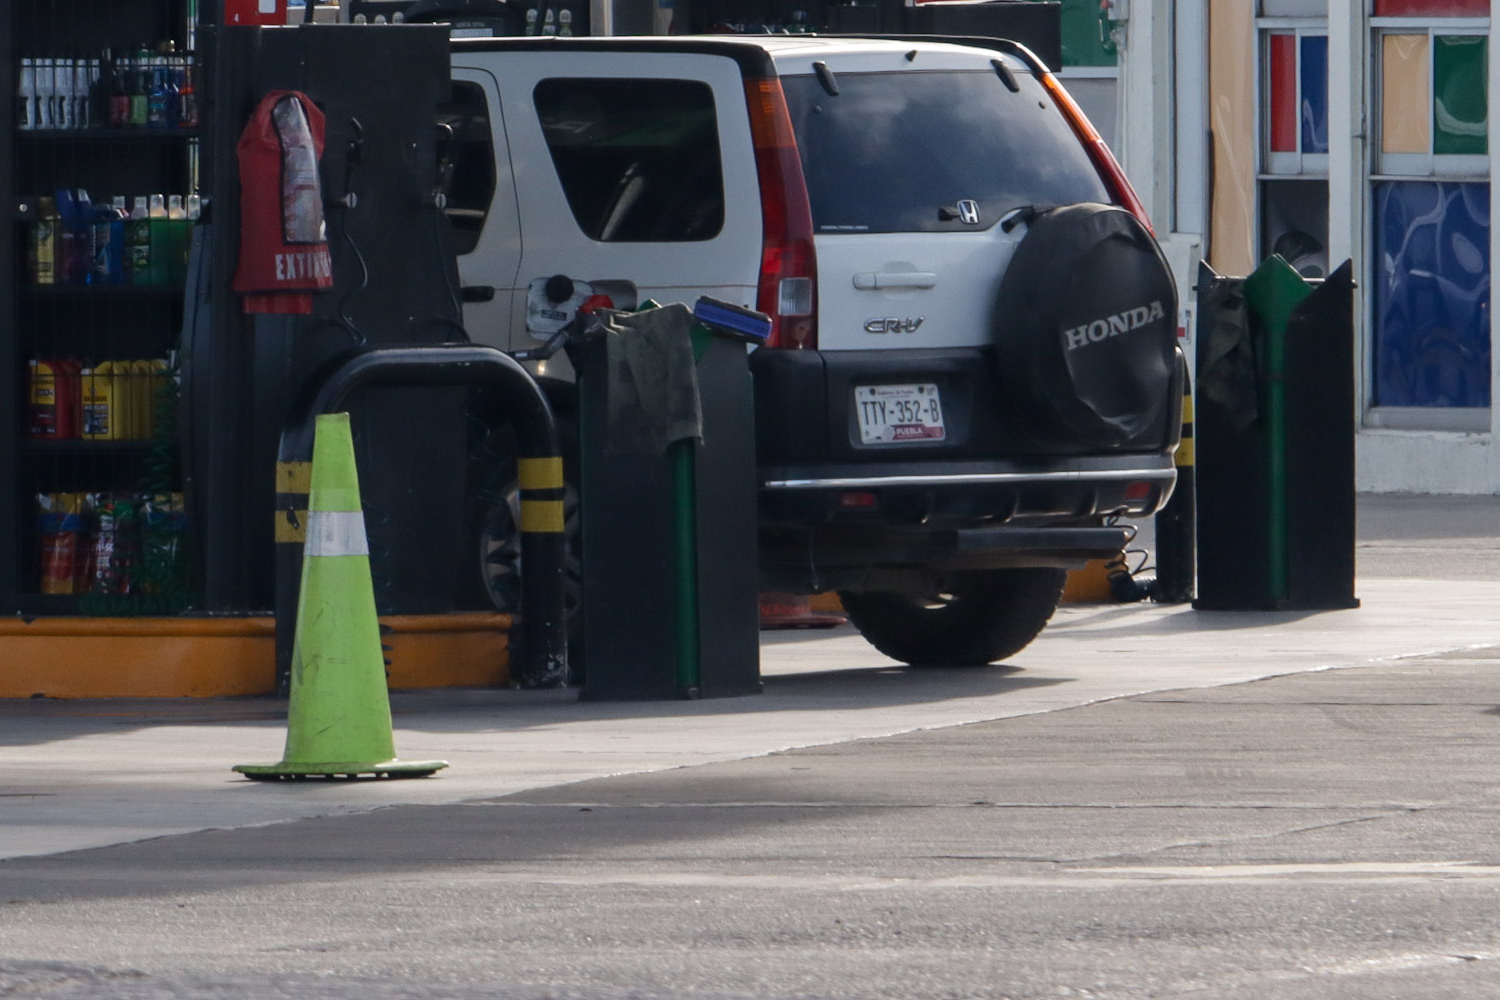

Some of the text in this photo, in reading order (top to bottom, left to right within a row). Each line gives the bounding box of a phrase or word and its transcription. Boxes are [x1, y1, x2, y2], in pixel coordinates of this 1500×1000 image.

[864, 316, 925, 334] CR-V
[1064, 301, 1165, 350] HONDA
[861, 399, 939, 425] TTY-352-B
[896, 427, 923, 435] PUEBLA
